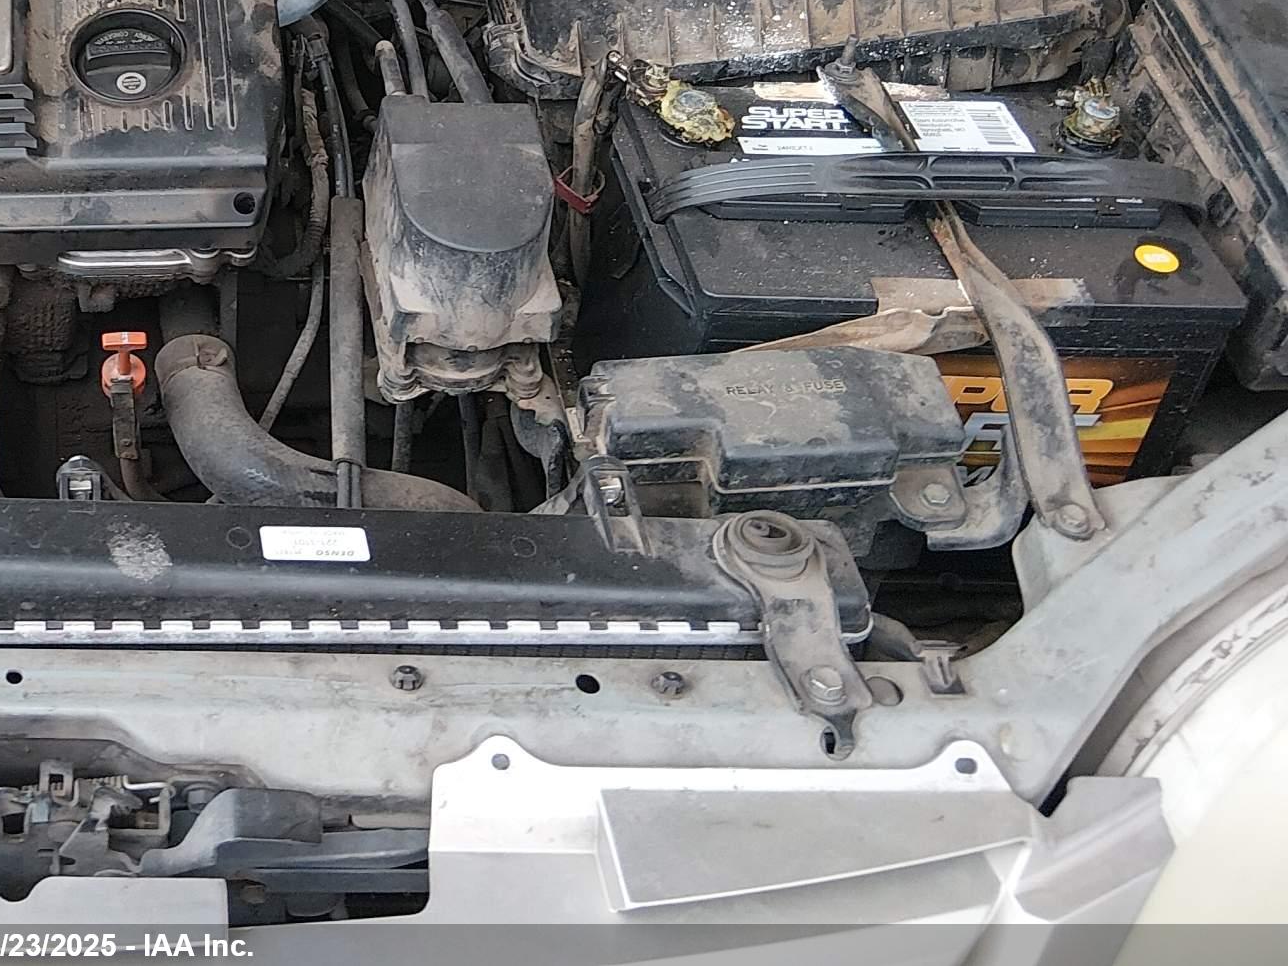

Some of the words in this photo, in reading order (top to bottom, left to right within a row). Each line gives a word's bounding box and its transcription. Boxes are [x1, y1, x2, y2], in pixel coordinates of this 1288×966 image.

[748, 106, 844, 118] SUPER
[741, 116, 848, 130] START
[726, 384, 774, 395] RELAY
[803, 379, 843, 392] FUSE
